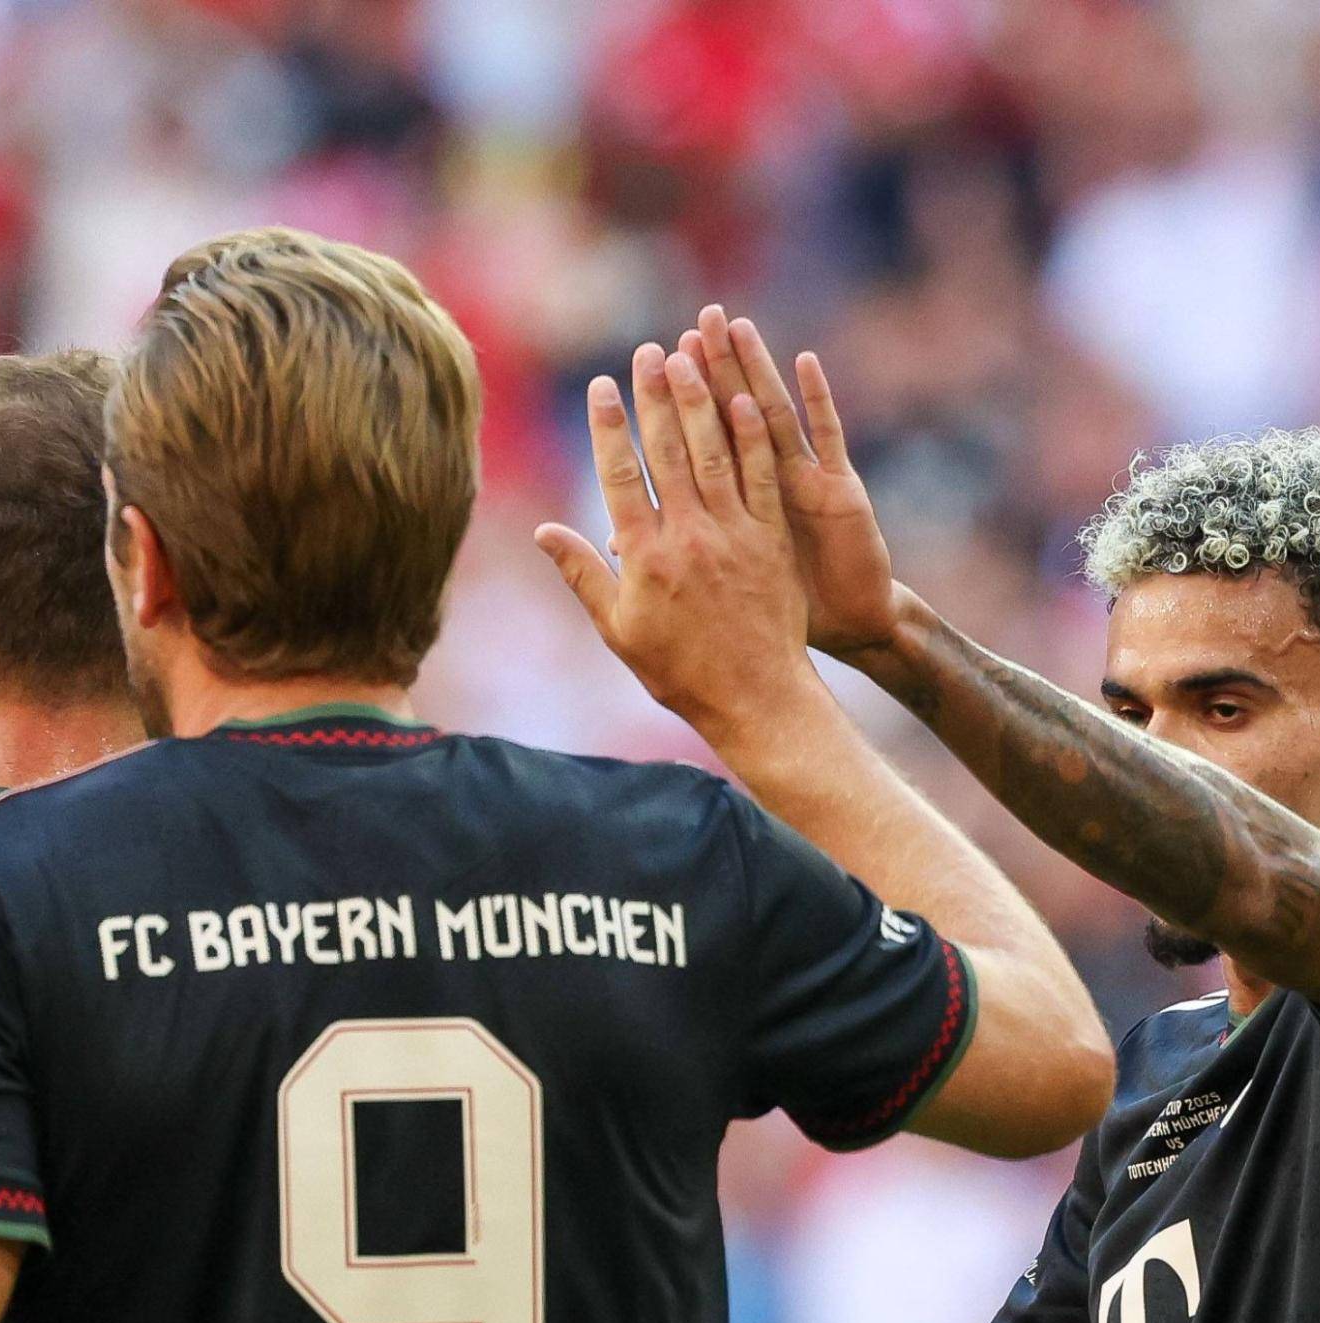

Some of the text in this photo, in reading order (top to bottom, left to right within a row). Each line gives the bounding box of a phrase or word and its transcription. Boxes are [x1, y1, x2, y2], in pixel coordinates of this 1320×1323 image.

[98, 892, 687, 980] FC BAYERN MÜNCHEN
[1165, 1099, 1183, 1117] CUP
[1184, 1091, 1221, 1111] 2025
[1127, 1154, 1179, 1181] TOTTENHO
